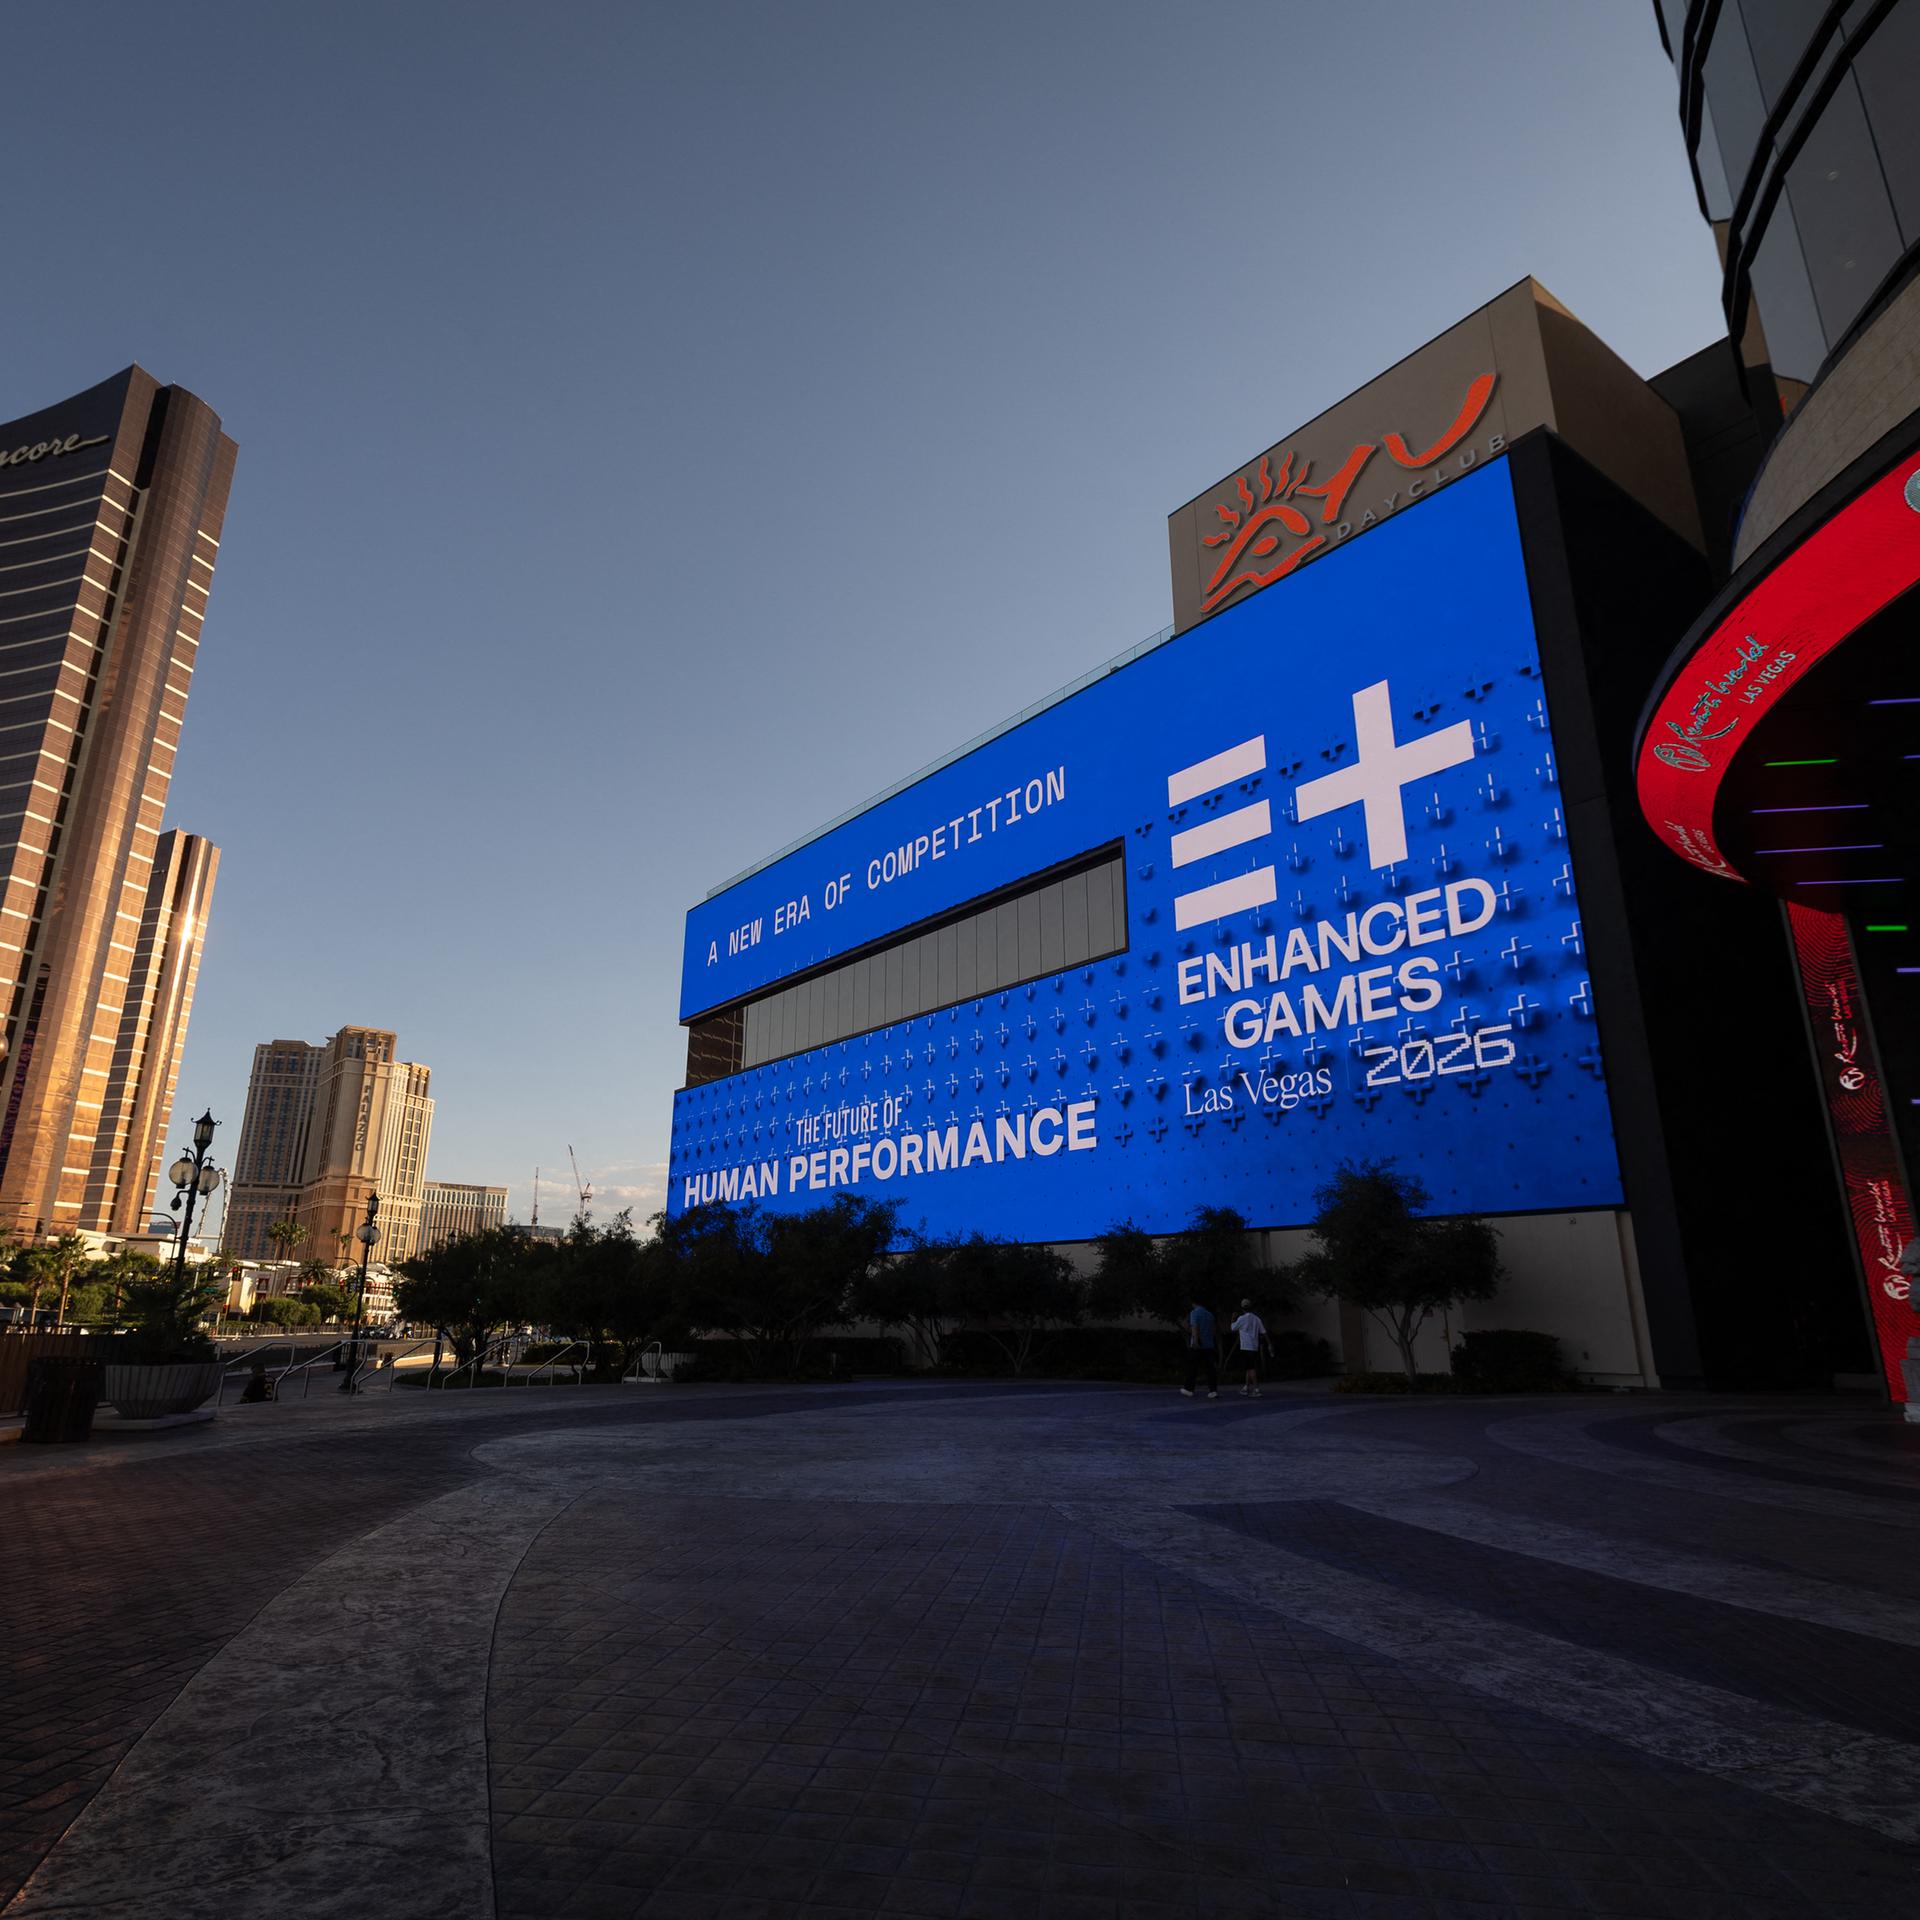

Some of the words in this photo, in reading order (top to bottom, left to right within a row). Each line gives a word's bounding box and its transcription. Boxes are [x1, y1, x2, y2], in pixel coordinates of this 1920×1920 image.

[1336, 434, 1508, 541] DAYCLUB
[1739, 684, 1763, 704] LAS
[1754, 650, 1797, 685] VEGAS
[707, 941, 718, 966] A
[729, 919, 763, 956] NEW
[774, 895, 810, 935] ERA
[825, 873, 851, 910] OF
[868, 766, 1065, 890] COMPETITION
[1178, 878, 1497, 1005] ENHANCED
[1224, 957, 1442, 1049] GAMES
[1184, 1082, 1233, 1116] Las
[1240, 1066, 1333, 1110] Vegas
[1364, 1023, 1516, 1087] 2026
[355, 1085, 372, 1151] PALAZZO
[684, 1161, 779, 1209] HUMAN
[789, 1101, 1097, 1193] PERFORMANCE
[796, 1116, 821, 1145] THE
[824, 1103, 878, 1141] FUTURE
[883, 1096, 903, 1129] OF
